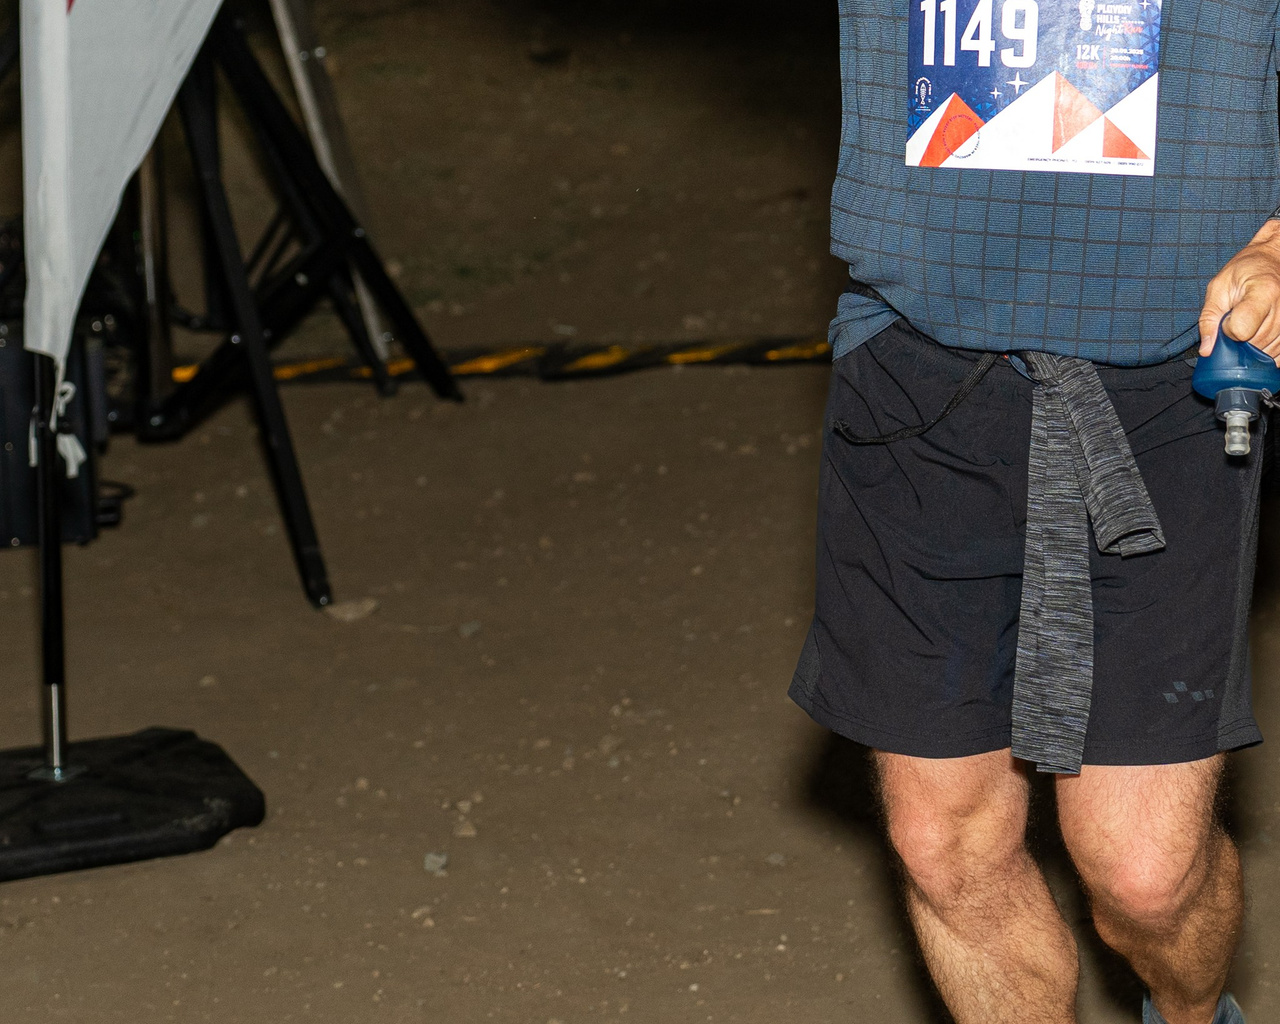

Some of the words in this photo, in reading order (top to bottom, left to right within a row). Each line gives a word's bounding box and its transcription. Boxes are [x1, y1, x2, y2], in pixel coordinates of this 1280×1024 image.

[1096, 4, 1133, 14] PLOVDIV
[1096, 14, 1120, 24] HILLS
[1095, 23, 1124, 41] Night
[1076, 44, 1100, 60] 12K
